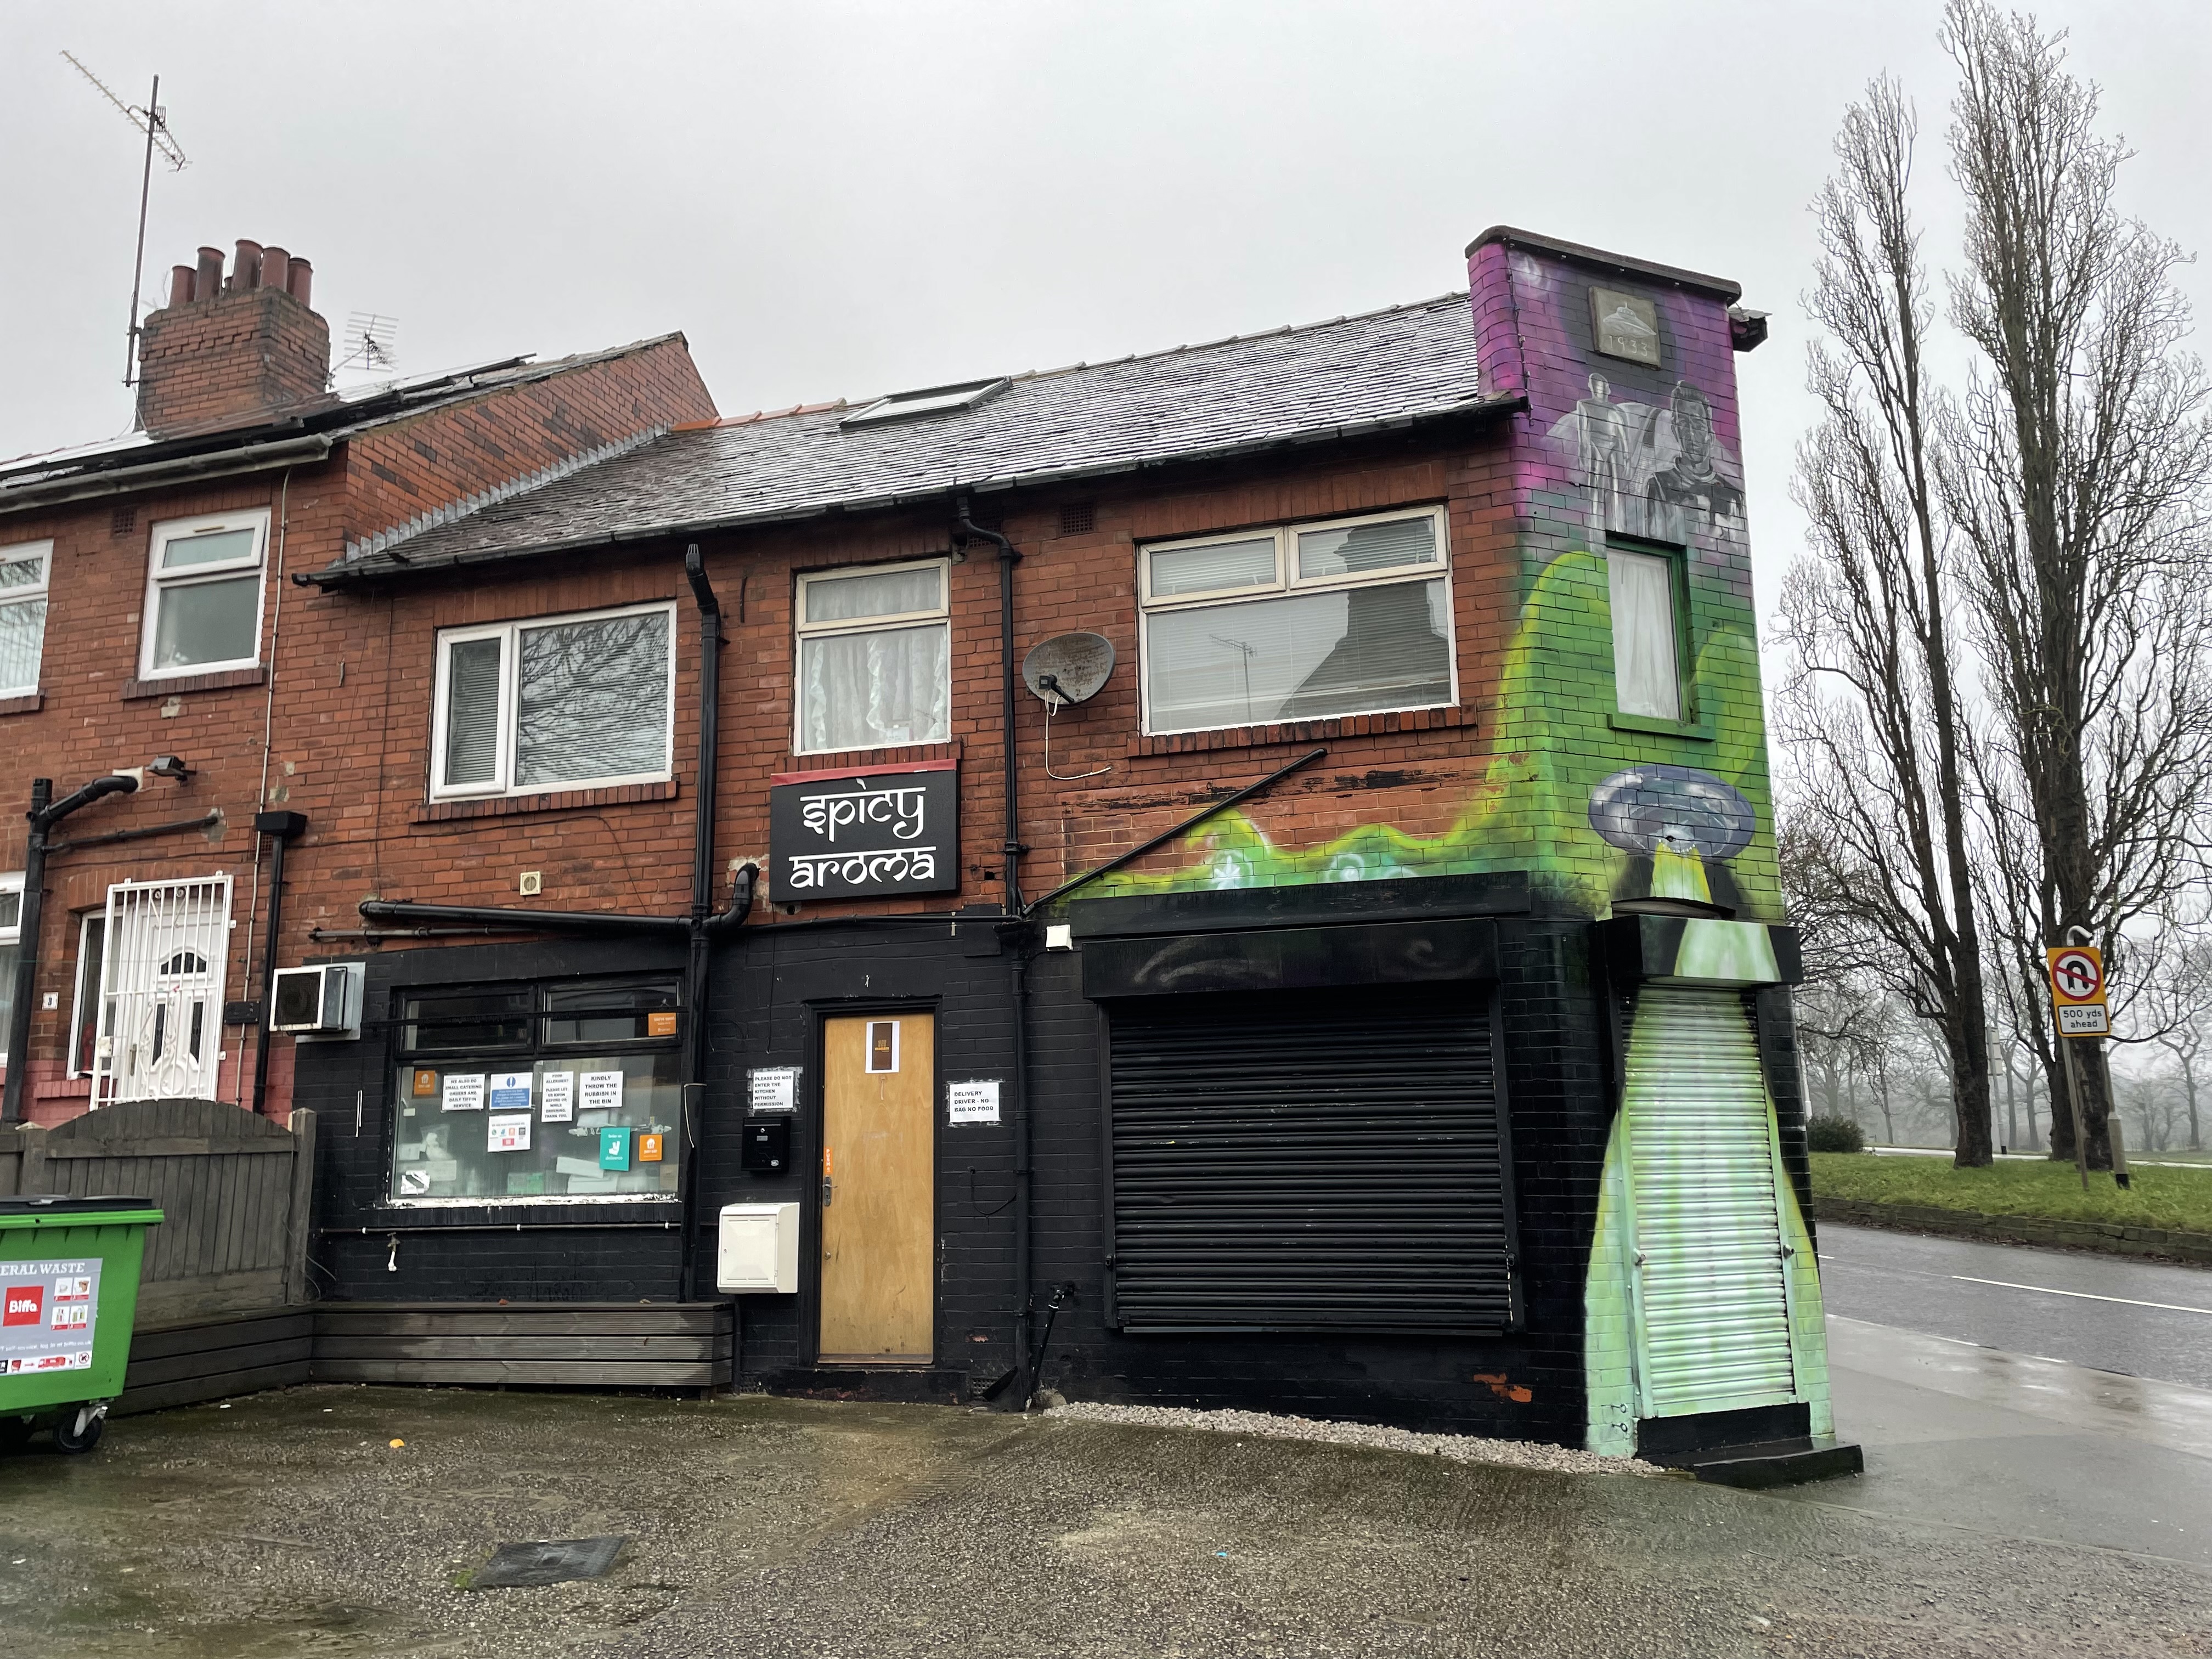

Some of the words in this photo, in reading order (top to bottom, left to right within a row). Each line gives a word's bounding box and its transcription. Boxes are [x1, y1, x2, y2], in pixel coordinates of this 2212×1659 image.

[1609, 335, 1647, 357] 1933
[800, 778, 926, 842] spicy
[789, 846, 936, 888] aroma
[2086, 1009, 2102, 1019] yds
[40, 1262, 85, 1274] WASTE
[9, 1300, 37, 1313] Biffa
